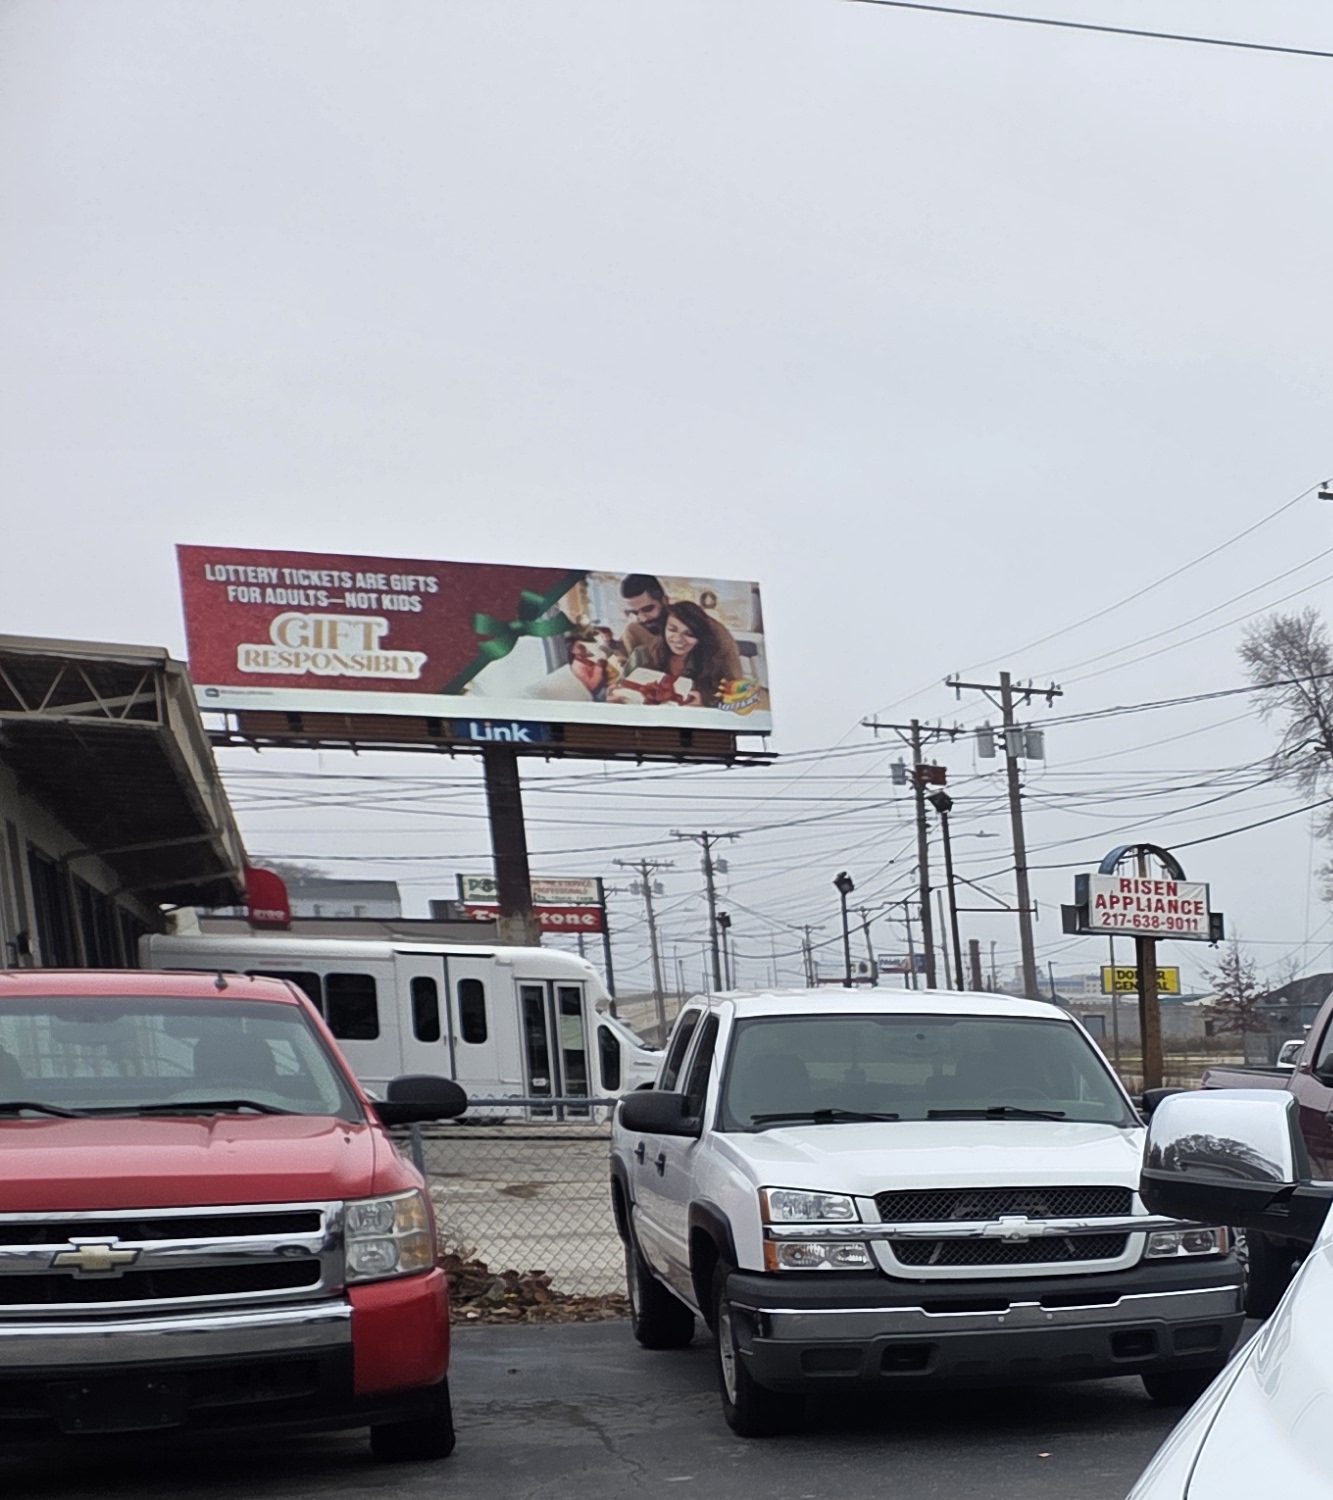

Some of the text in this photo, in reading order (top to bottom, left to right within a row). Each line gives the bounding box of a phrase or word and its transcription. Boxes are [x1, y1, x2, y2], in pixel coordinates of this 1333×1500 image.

[204, 563, 440, 593] LOTTERY TICKETS ARE GIFTS
[227, 585, 262, 603] FOR
[381, 594, 423, 612] KIDS
[276, 616, 383, 651] GIFT
[243, 650, 420, 674] RESPONSIBLY
[470, 721, 533, 743] Link
[1119, 878, 1178, 897] RISEN
[1095, 894, 1205, 916] APPLIANCE
[1101, 912, 1198, 931] 217-638-9011
